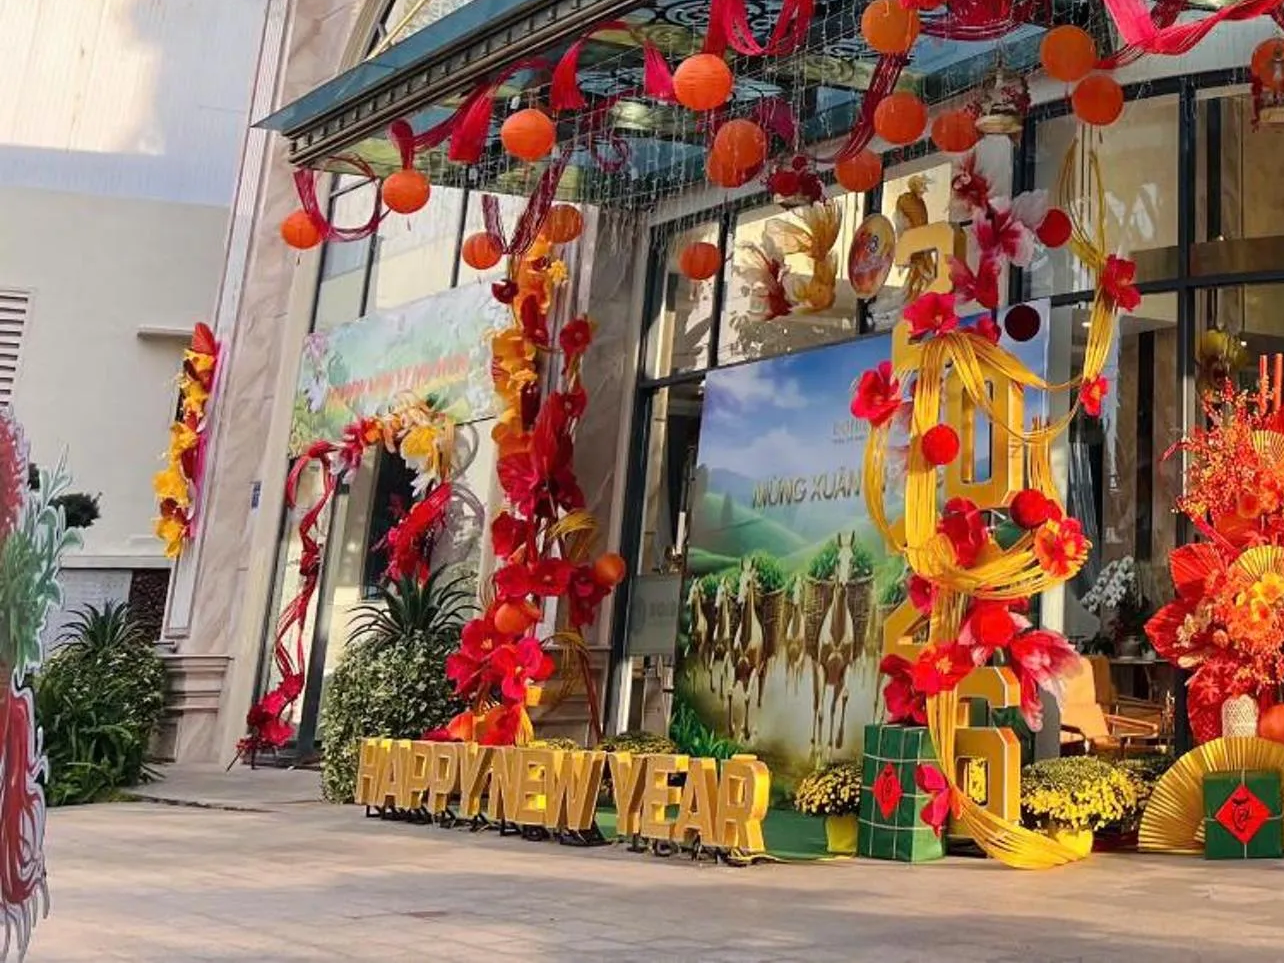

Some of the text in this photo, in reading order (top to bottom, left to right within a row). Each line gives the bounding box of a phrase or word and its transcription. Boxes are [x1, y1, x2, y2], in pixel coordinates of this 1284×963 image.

[355, 738, 770, 853] HAPPY NEW YEAR
